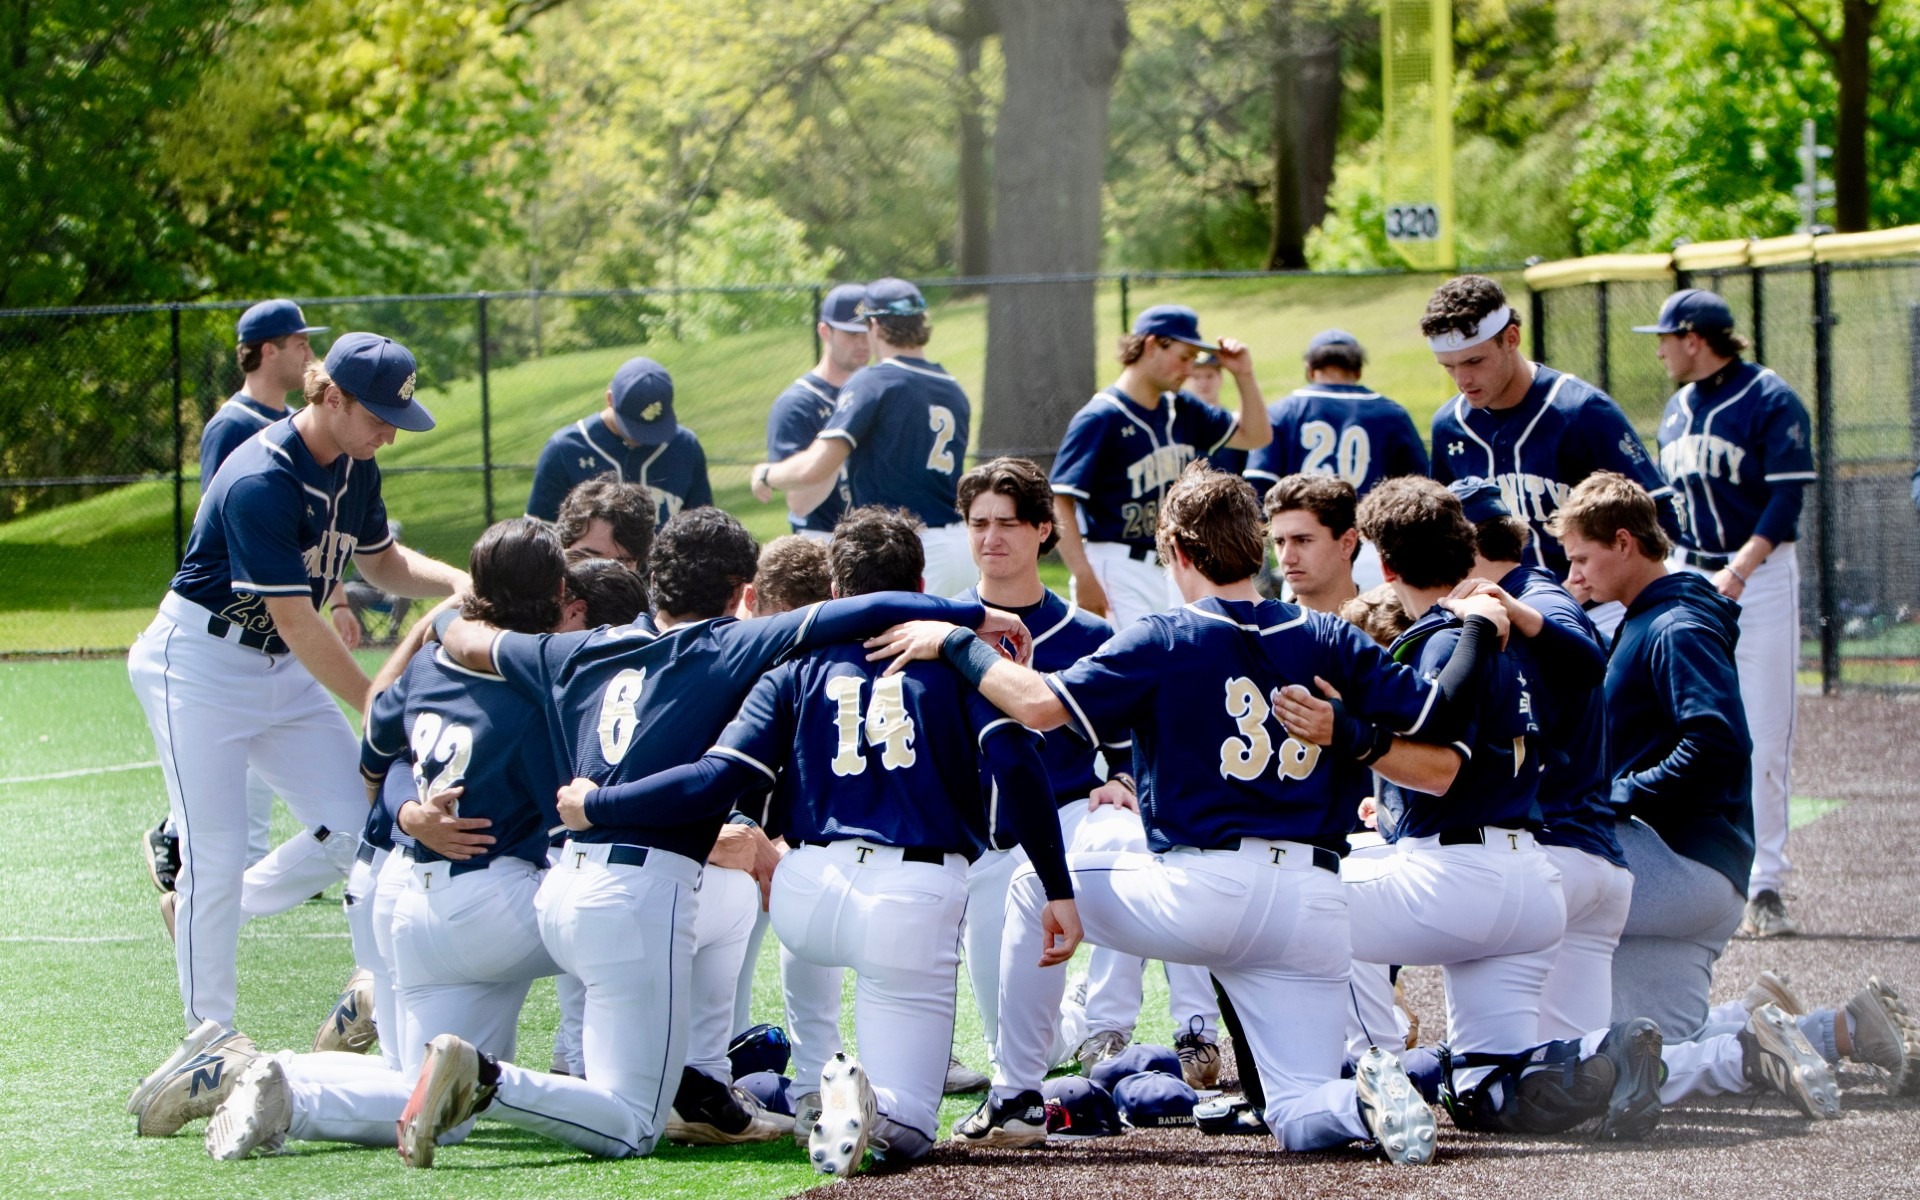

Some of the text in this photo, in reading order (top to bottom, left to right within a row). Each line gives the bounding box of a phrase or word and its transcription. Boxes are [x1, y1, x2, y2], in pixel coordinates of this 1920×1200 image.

[1387, 208, 1438, 238] 320
[926, 404, 956, 475] 2
[1300, 420, 1371, 490] 20
[1127, 443, 1195, 499] TRINIT
[597, 666, 646, 766] 6
[825, 671, 916, 777] 14
[1507, 834, 1518, 850] T
[575, 851, 587, 869] T
[857, 846, 874, 864] T
[1269, 846, 1286, 865] T
[423, 871, 433, 889] T
[1024, 1106, 1044, 1119] NB
